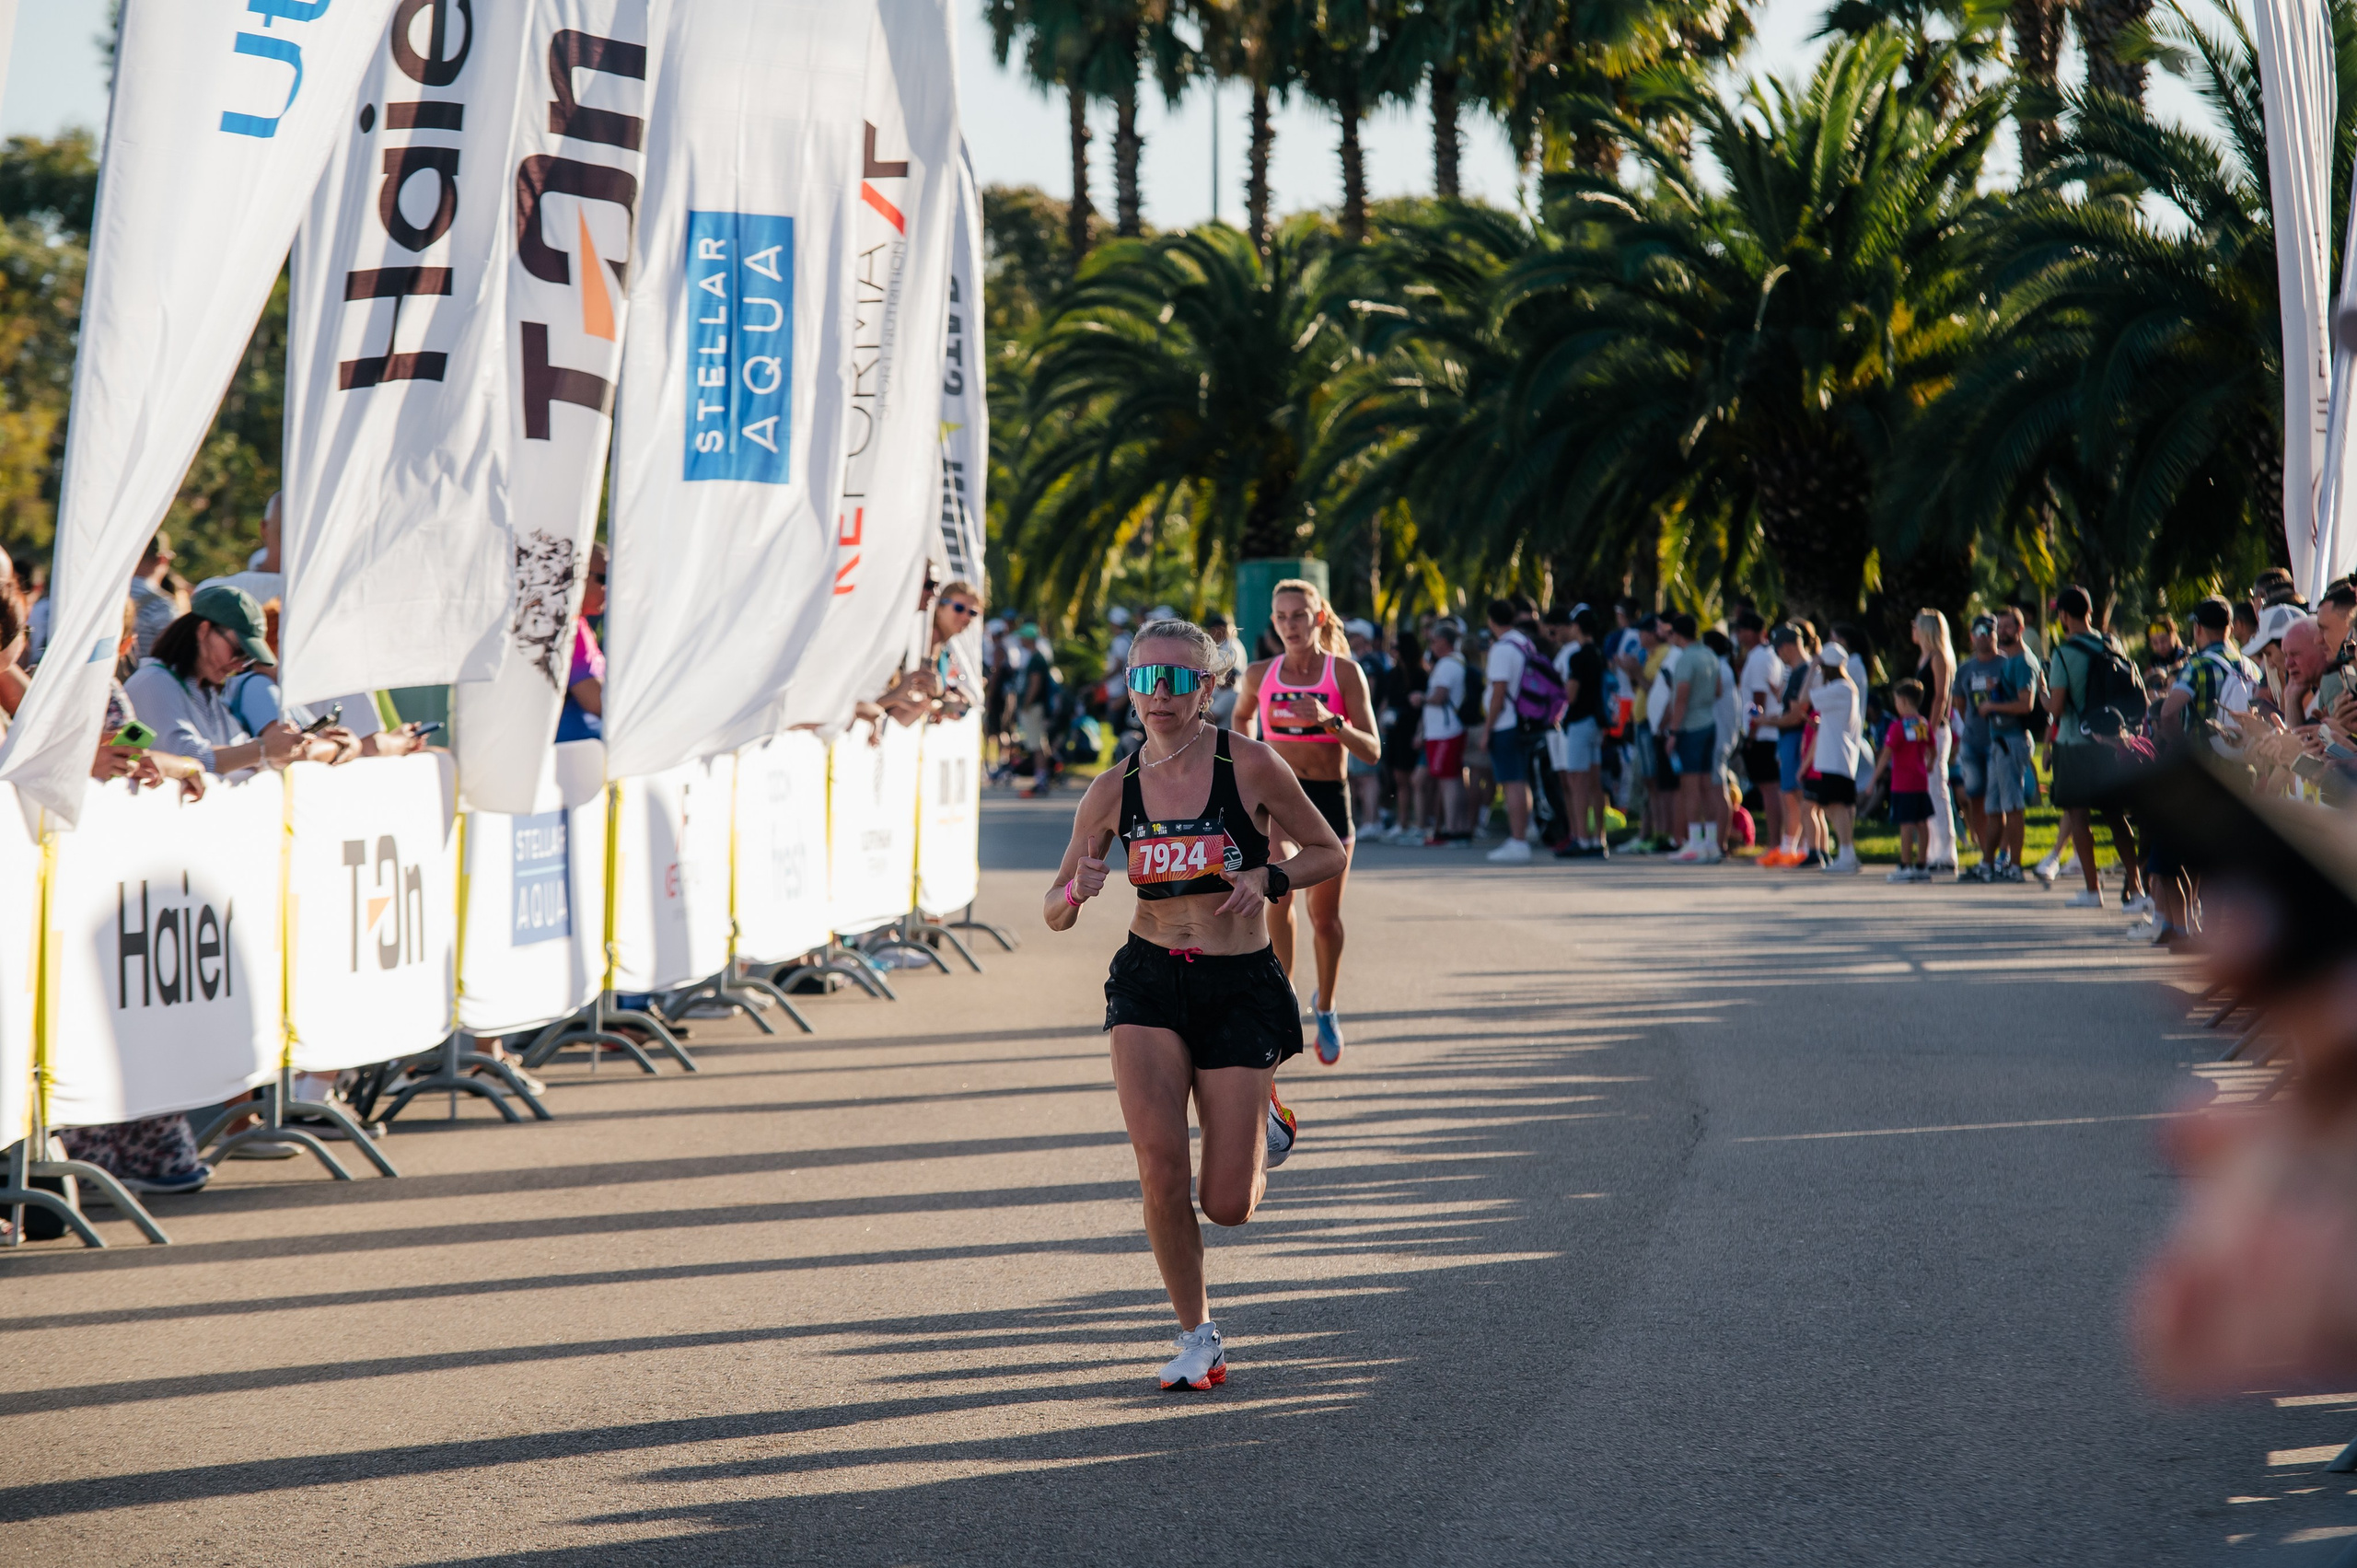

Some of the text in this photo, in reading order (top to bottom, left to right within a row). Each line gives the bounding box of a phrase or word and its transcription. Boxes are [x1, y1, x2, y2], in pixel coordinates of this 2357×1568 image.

[695, 237, 727, 453] STELLAR
[741, 244, 783, 454] AQUA
[516, 878, 568, 931] AQUA
[1140, 842, 1207, 876] 7924
[118, 868, 233, 1010] Haier
